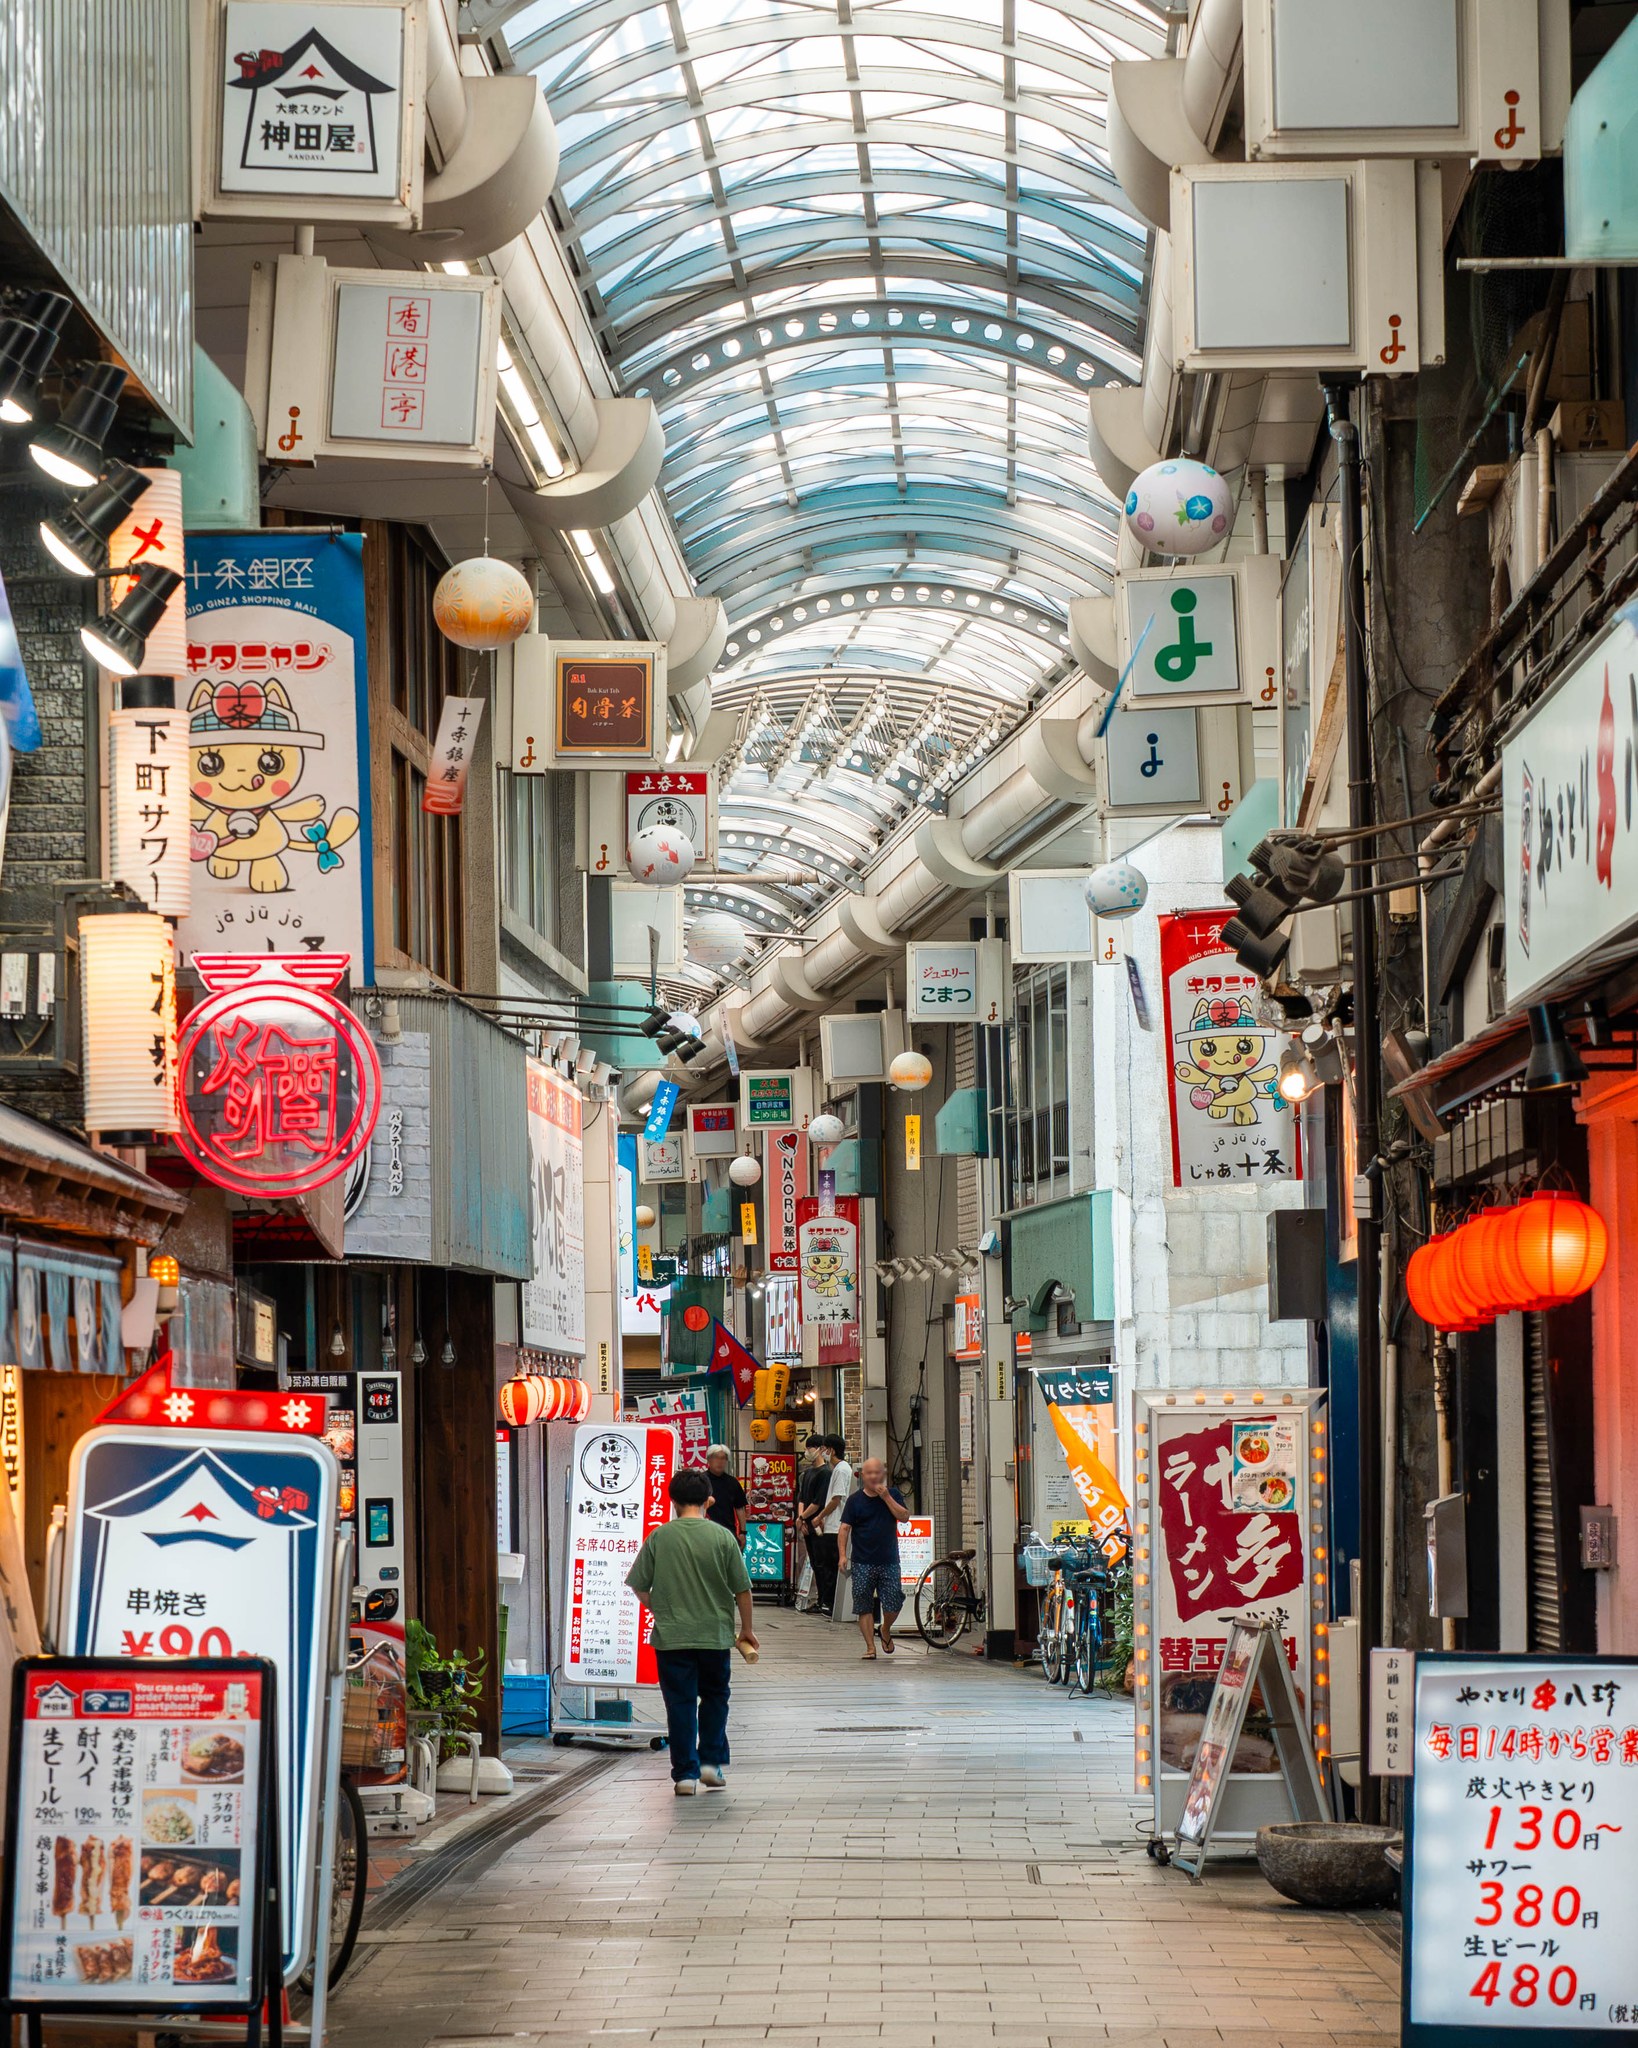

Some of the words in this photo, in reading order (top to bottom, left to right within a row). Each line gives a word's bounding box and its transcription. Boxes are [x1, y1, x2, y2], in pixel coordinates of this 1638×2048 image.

[276, 103, 344, 116] 大衆スタンド
[261, 120, 355, 152] 神田屋
[390, 301, 427, 424] 香港亭
[206, 595, 238, 608] GINZA
[242, 595, 291, 607] SHOPPING
[294, 601, 318, 615] MALL
[187, 642, 328, 672] キタニャン
[441, 706, 472, 783] 十条銀座
[638, 776, 694, 792] 立呑み
[135, 720, 170, 903] 下町サワー
[1204, 947, 1222, 956] GINZA
[923, 967, 970, 980] ジュエリー
[921, 986, 971, 1003] こまつ
[775, 1256, 798, 1268] 十条
[753, 1476, 789, 1487] サービス
[773, 1486, 793, 1498] セット
[596, 1521, 620, 1530] 十条店
[1164, 1451, 1215, 1600] ラーメン
[576, 1538, 639, 1554] 各席40名様
[575, 1567, 583, 1596] お食事
[126, 1587, 207, 1617] 串焼き
[571, 1616, 580, 1655] お飲み物
[135, 1683, 153, 1692] You
[172, 1683, 204, 1694] easily
[135, 1693, 163, 1702] order
[164, 1693, 189, 1702] from
[190, 1695, 215, 1704] your
[42, 1726, 64, 1805] 生ビール
[77, 1726, 101, 1787] 酎ハイ
[1465, 1776, 1596, 1803] 炭火やきとり
[1465, 1860, 1532, 1878] サワー
[1474, 1881, 1599, 1929] 380円
[1463, 1936, 1560, 1959] 生ビール
[1469, 1961, 1597, 2011] 480円
